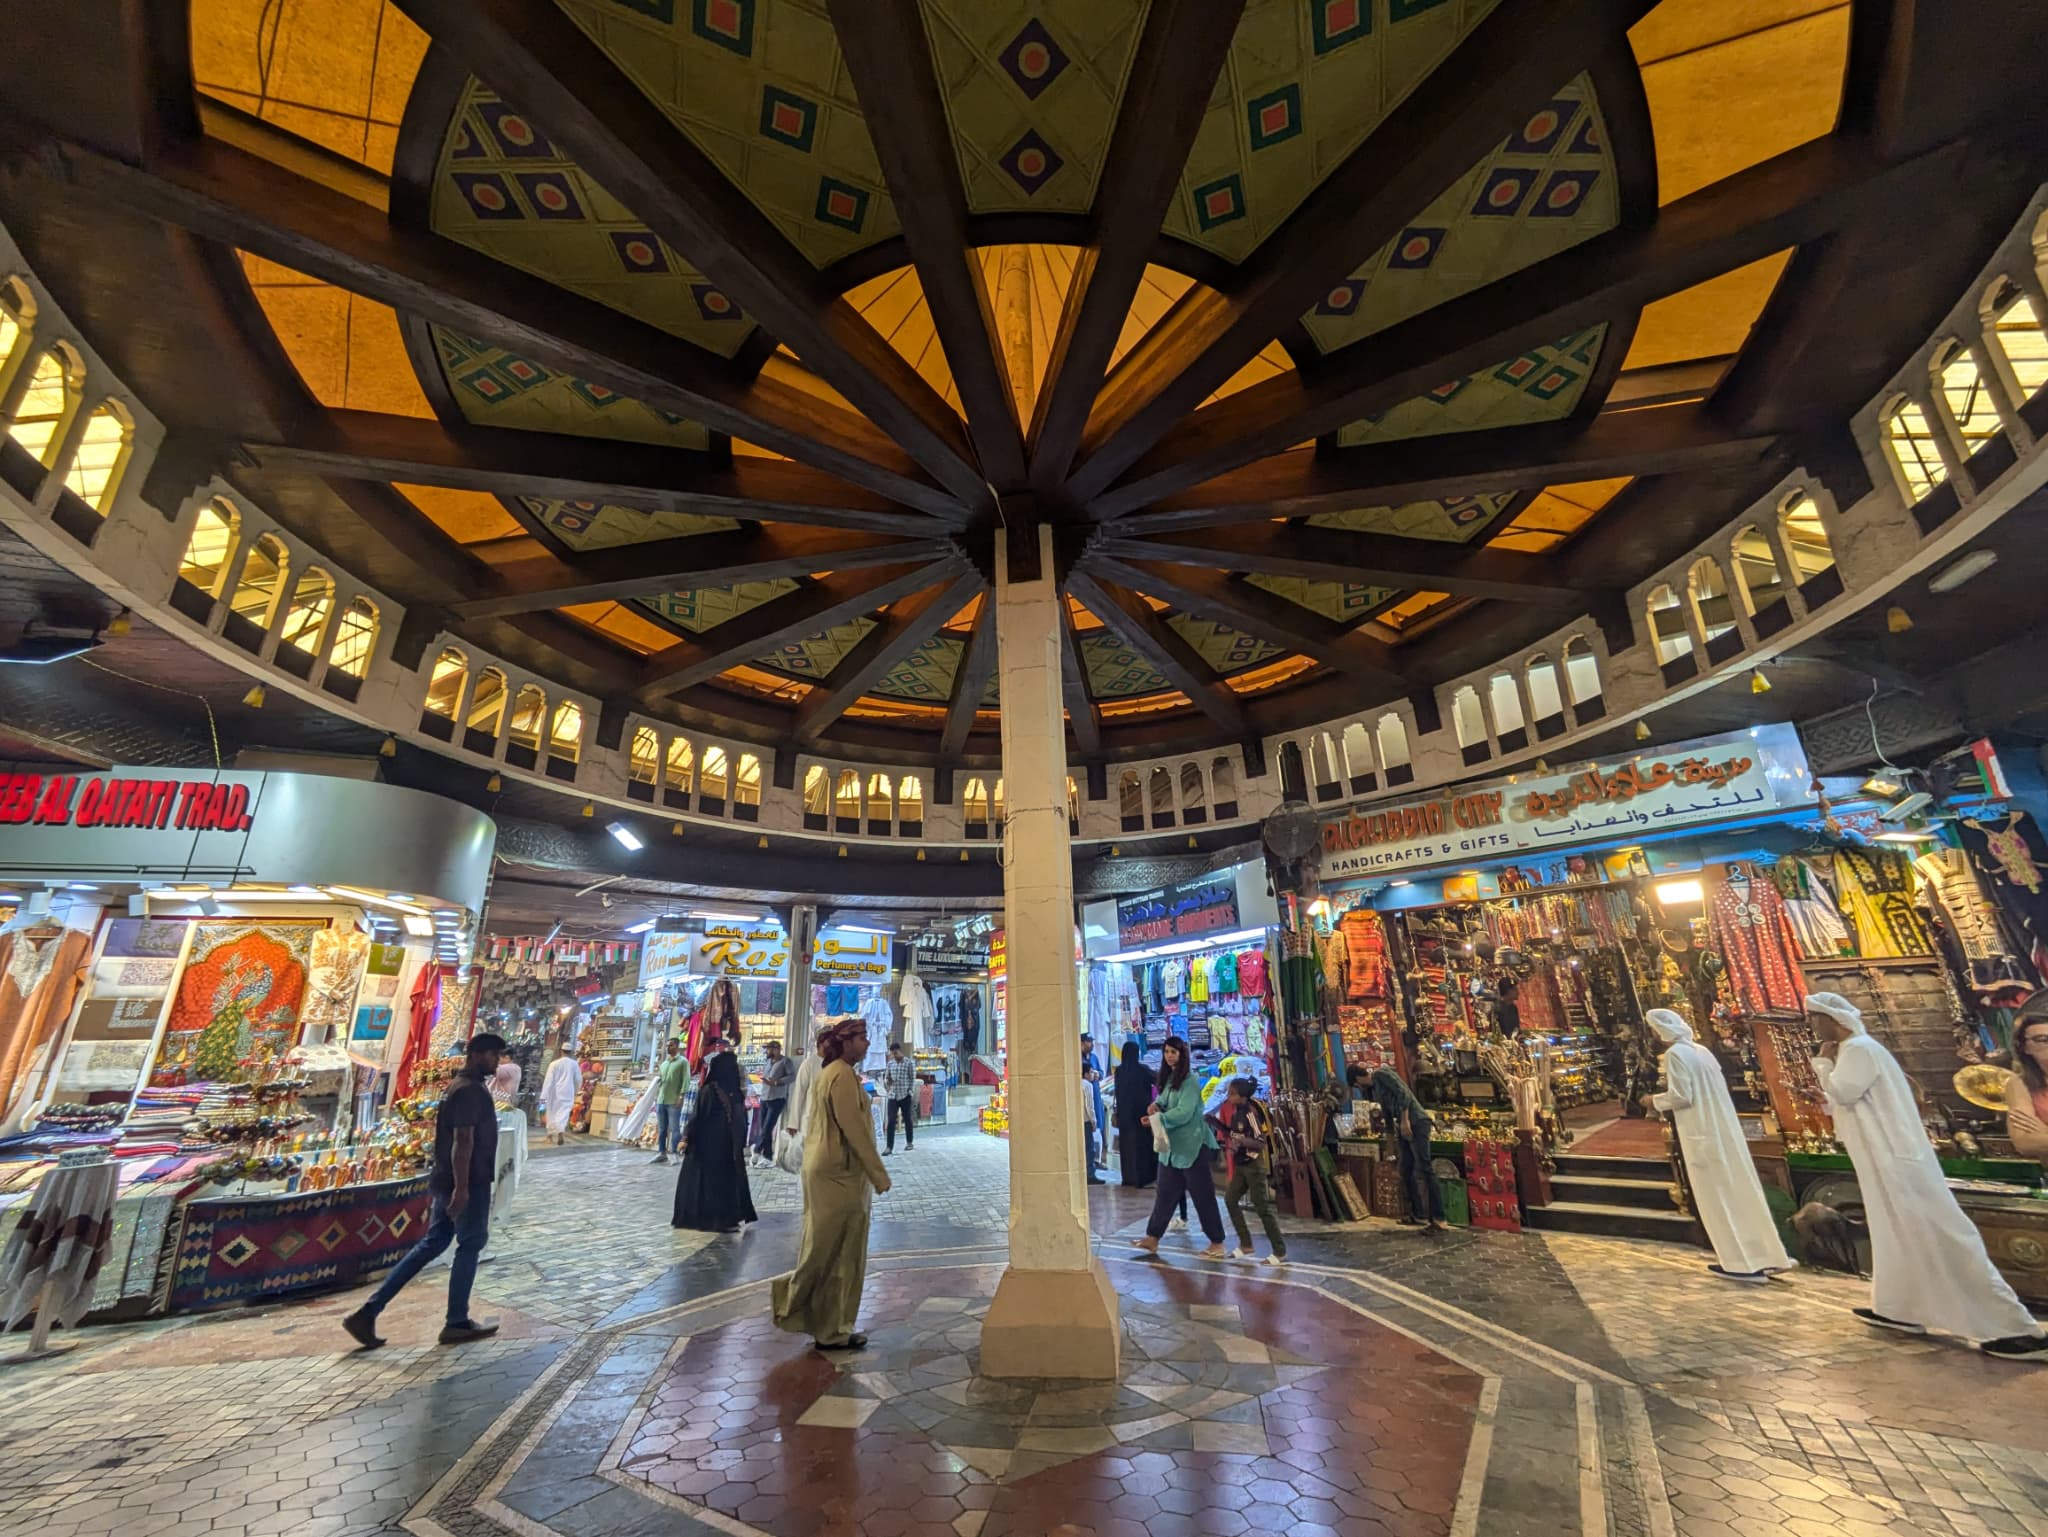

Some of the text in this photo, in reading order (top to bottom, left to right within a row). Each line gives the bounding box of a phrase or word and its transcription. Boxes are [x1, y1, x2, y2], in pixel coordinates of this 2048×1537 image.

[33, 775, 78, 824] AL
[1451, 790, 1504, 829] CITY
[1652, 788, 1765, 818] للتحف
[1534, 810, 1649, 838] والهدايا
[1331, 845, 1433, 872] HANDICRAFTS
[1441, 843, 1451, 854] &
[1460, 833, 1510, 850] GIFTS
[701, 938, 788, 967] Ros
[816, 959, 857, 971] Perfumes
[866, 962, 887, 974] Bags
